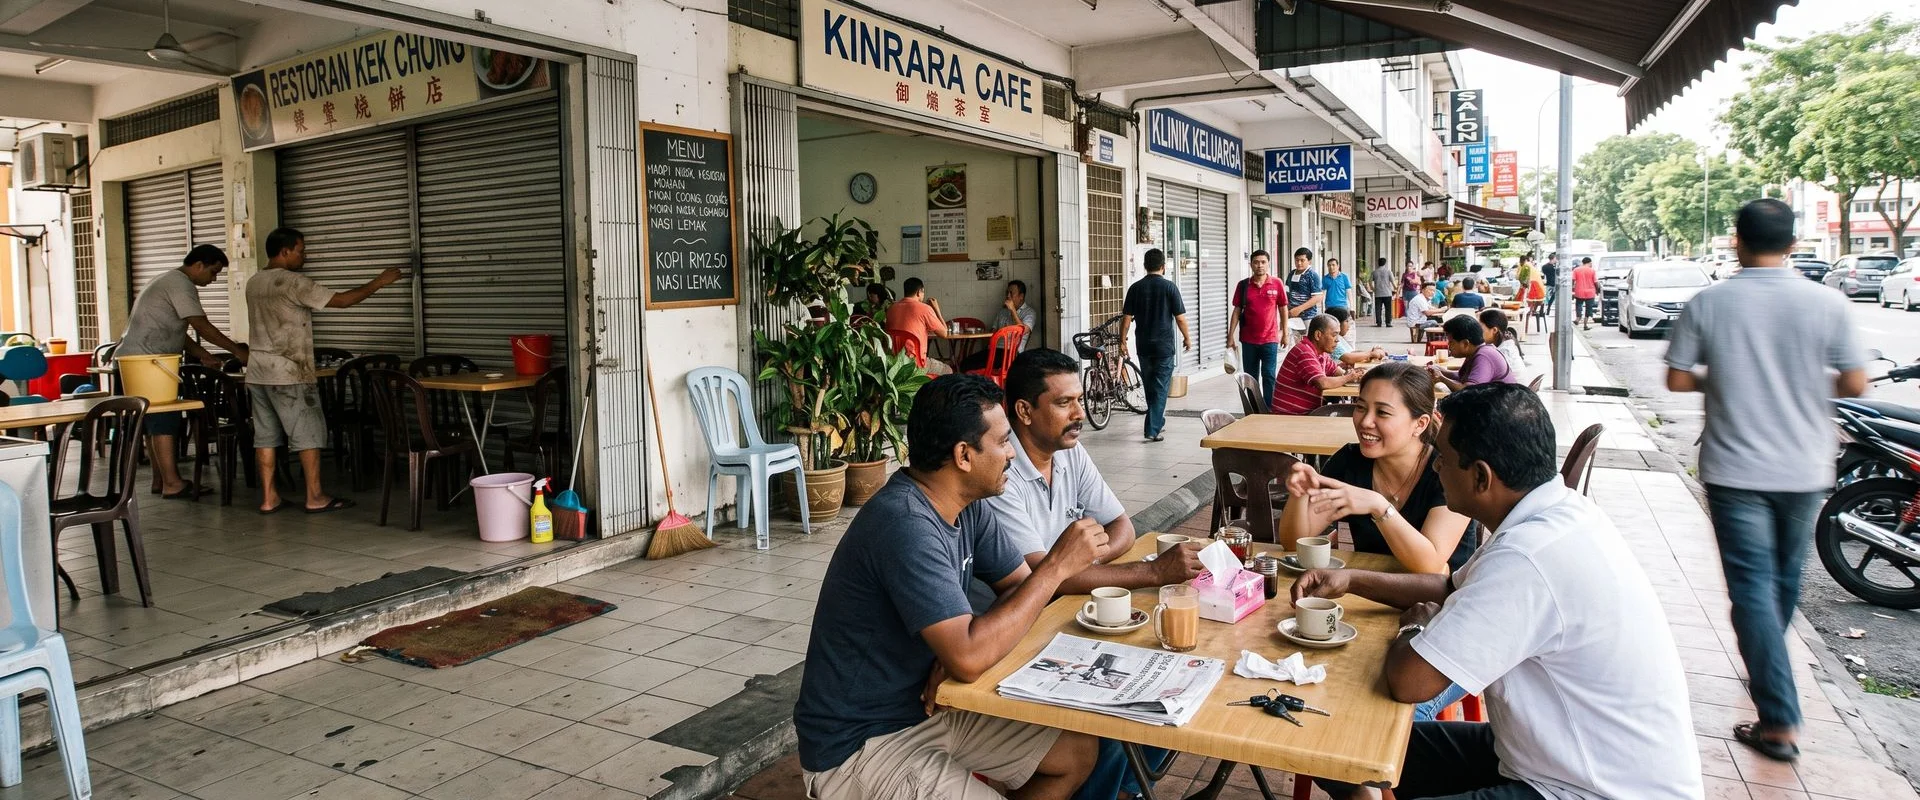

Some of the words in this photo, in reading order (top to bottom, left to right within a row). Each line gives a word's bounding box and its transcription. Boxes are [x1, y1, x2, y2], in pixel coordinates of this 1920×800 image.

[824, 8, 966, 94] KINRARA
[975, 62, 1033, 114] CAFE
[269, 51, 352, 108] RESTORAN
[353, 39, 392, 88] KEK
[1457, 90, 1478, 142] SALON
[666, 138, 705, 159] MENU
[1152, 110, 1190, 153] KLINIK
[1192, 125, 1241, 171] KELUARGA
[1276, 148, 1340, 168] KLINIK
[1268, 166, 1348, 184] KELUARGA
[1366, 195, 1419, 211] SALON
[650, 217, 673, 230] NASI
[677, 219, 707, 232] LEMAK
[655, 251, 683, 270] KOPI
[689, 251, 728, 269] RM2.50
[656, 274, 683, 290] NASI
[686, 274, 722, 290] LEMAK
